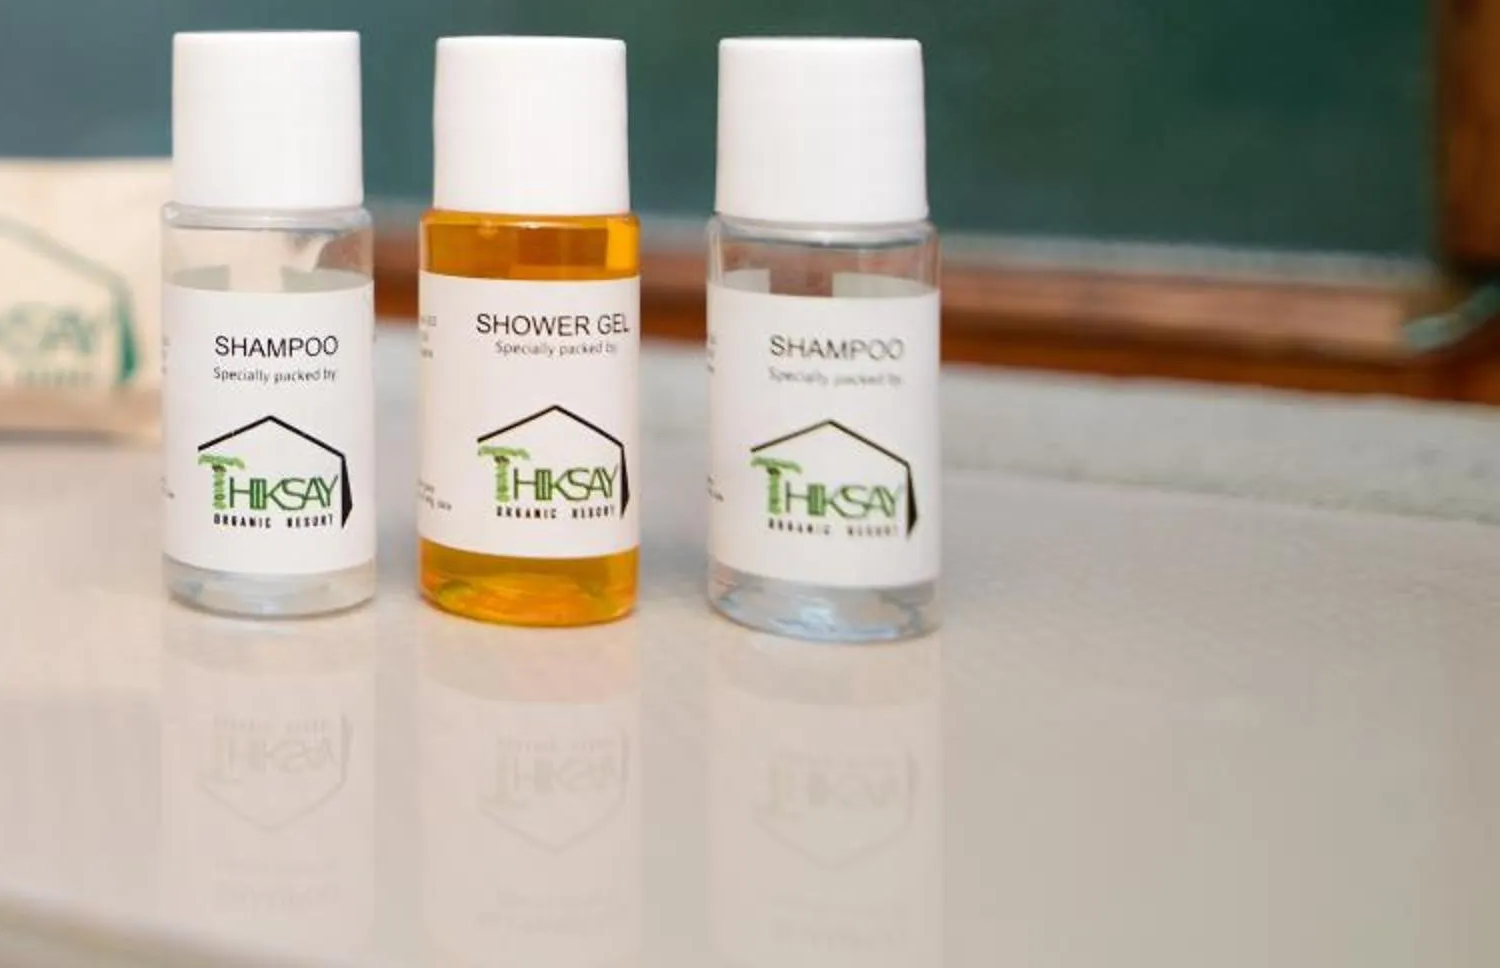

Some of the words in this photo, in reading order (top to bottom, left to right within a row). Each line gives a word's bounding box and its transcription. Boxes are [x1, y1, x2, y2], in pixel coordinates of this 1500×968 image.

[476, 313, 590, 337] SHOWER
[597, 312, 629, 335] GEL
[215, 334, 339, 358] SHAMPOO
[494, 339, 554, 357] Specially
[559, 340, 602, 357] packed
[769, 334, 905, 361] SHAMPOO
[213, 366, 269, 384] Specially
[274, 367, 320, 384] packed
[323, 367, 336, 382] by
[198, 454, 339, 510] THIKSAY
[478, 445, 618, 503] THIKSAY
[750, 456, 899, 518] THIKSAY
[213, 513, 271, 529] ORGANIC
[287, 514, 333, 529] RESORT
[496, 505, 557, 520] ORGANIC
